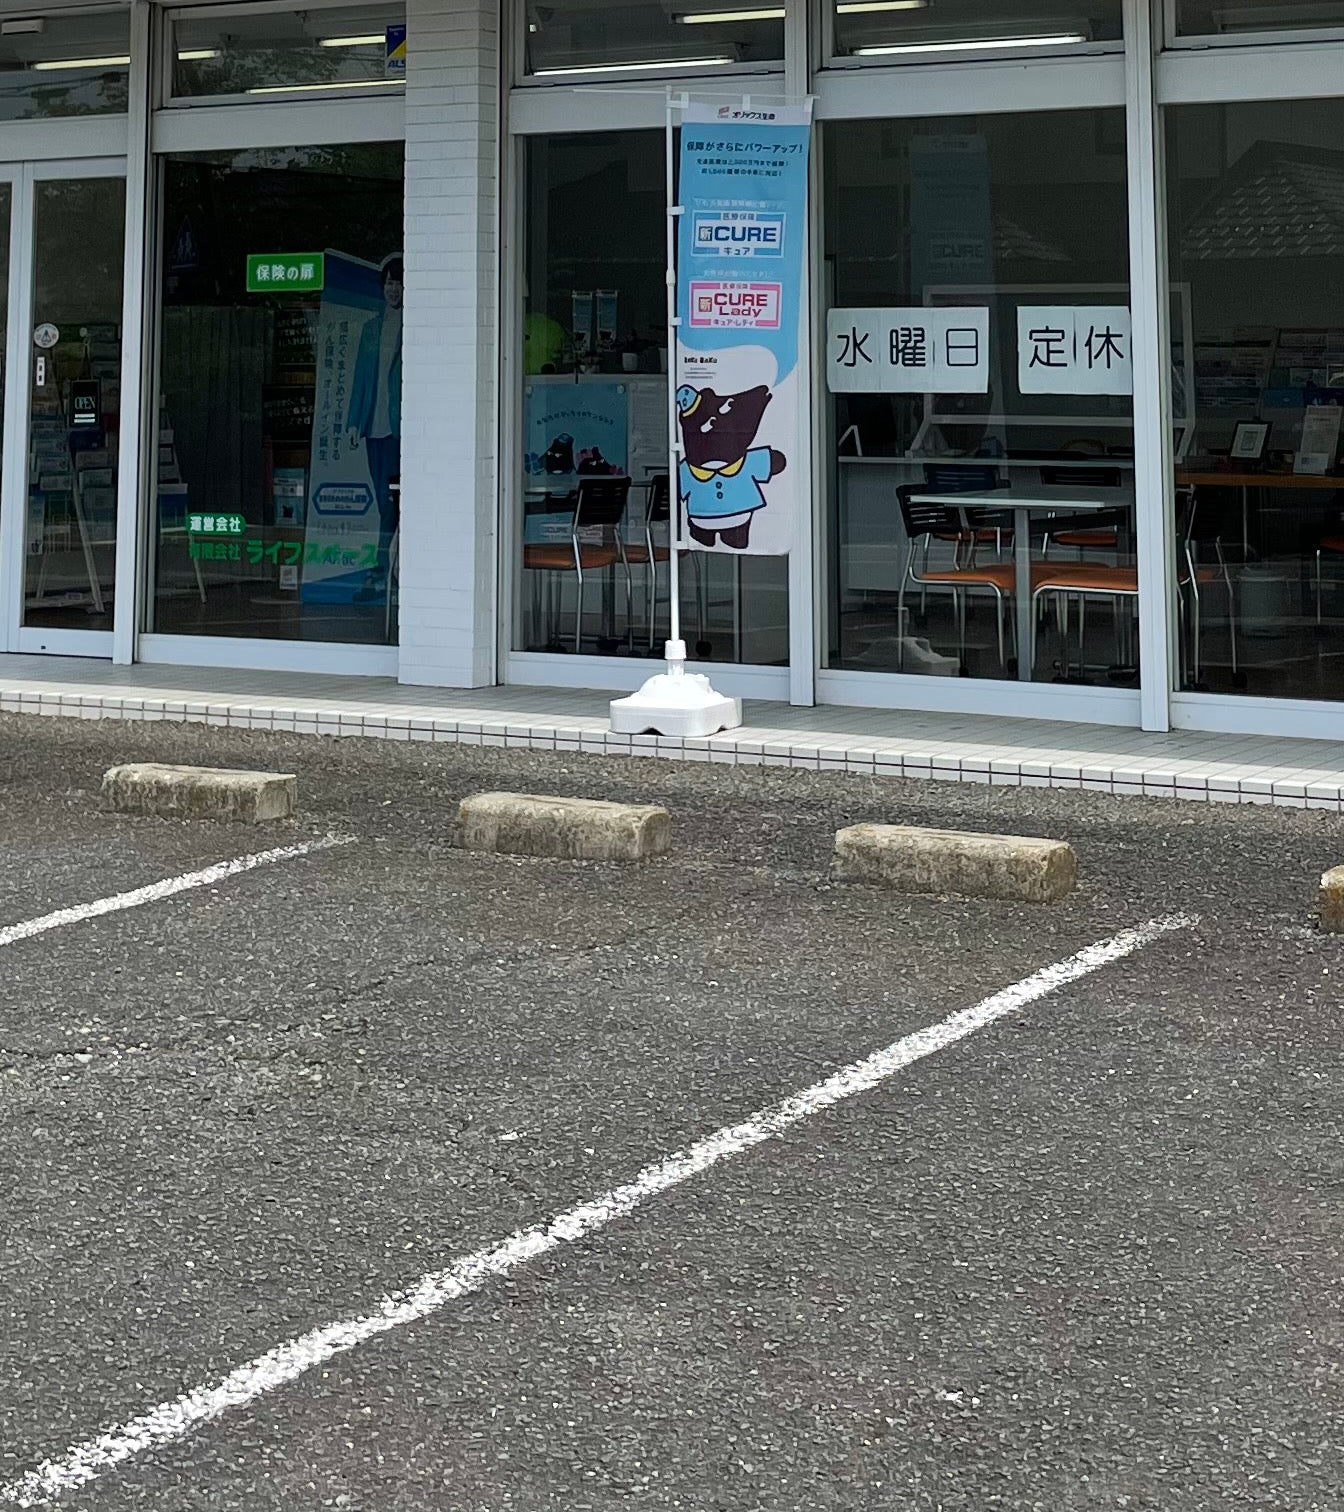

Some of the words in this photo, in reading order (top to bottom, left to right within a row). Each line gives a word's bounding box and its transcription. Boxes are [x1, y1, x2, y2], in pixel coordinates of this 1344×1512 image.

[723, 247, 750, 256] キュア
[256, 263, 314, 281] 保険の扉
[714, 293, 768, 306] CURE
[719, 306, 762, 317] Lady
[836, 326, 978, 368] 水曜日
[1029, 325, 1124, 370] 定休
[74, 396, 96, 410] OPEN
[190, 516, 241, 532] 運営会社
